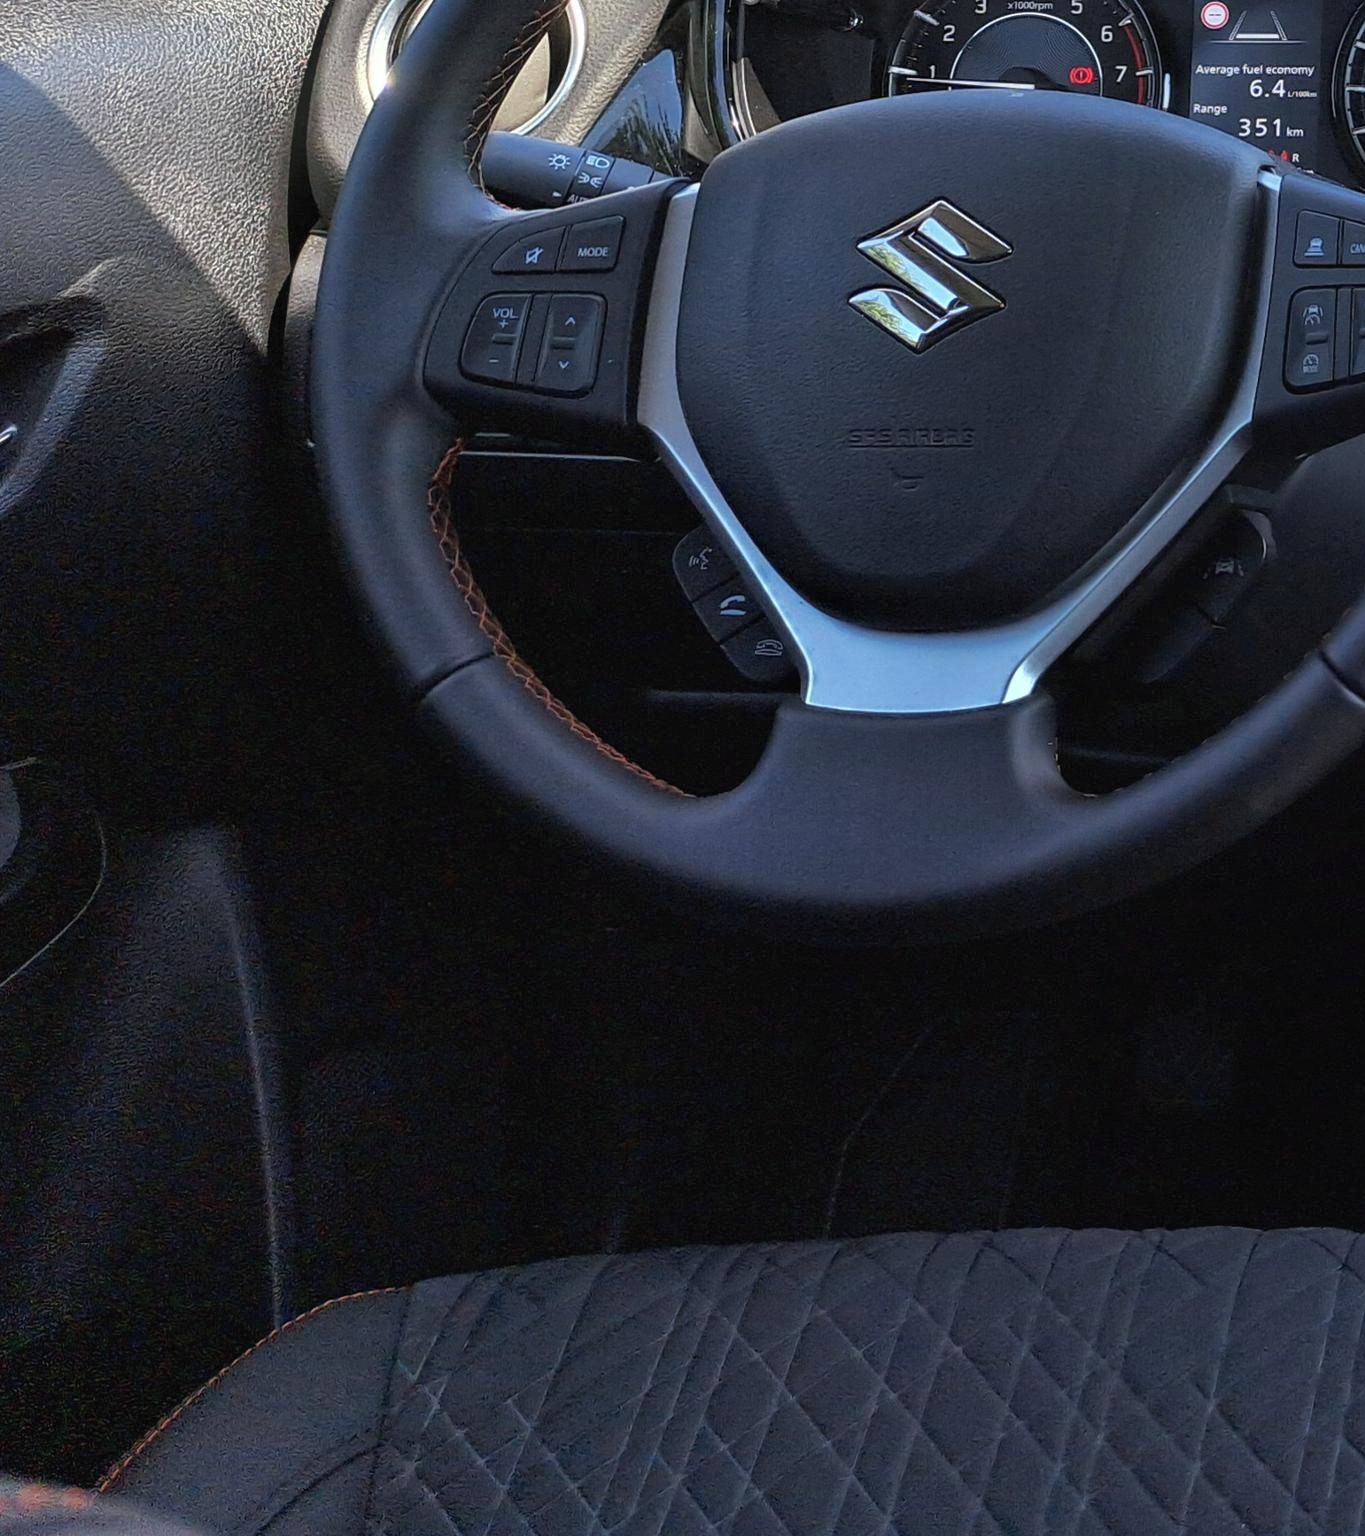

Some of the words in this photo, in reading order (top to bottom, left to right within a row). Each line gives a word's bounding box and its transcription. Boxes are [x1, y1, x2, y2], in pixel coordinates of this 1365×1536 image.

[1007, 0, 1054, 11] x1000rpm
[943, 25, 956, 42] 2
[1101, 25, 1113, 42] 6
[928, 65, 936, 79] 1
[1115, 65, 1127, 82] 7
[1195, 64, 1240, 76] Average
[1242, 64, 1264, 75] fuel
[1265, 66, 1315, 77] economy
[1249, 79, 1286, 98] 6.4
[1193, 103, 1228, 116] Range
[1238, 118, 1282, 137] 351
[1286, 126, 1304, 137] km
[577, 246, 609, 257] MODE
[493, 307, 519, 319] VOL
